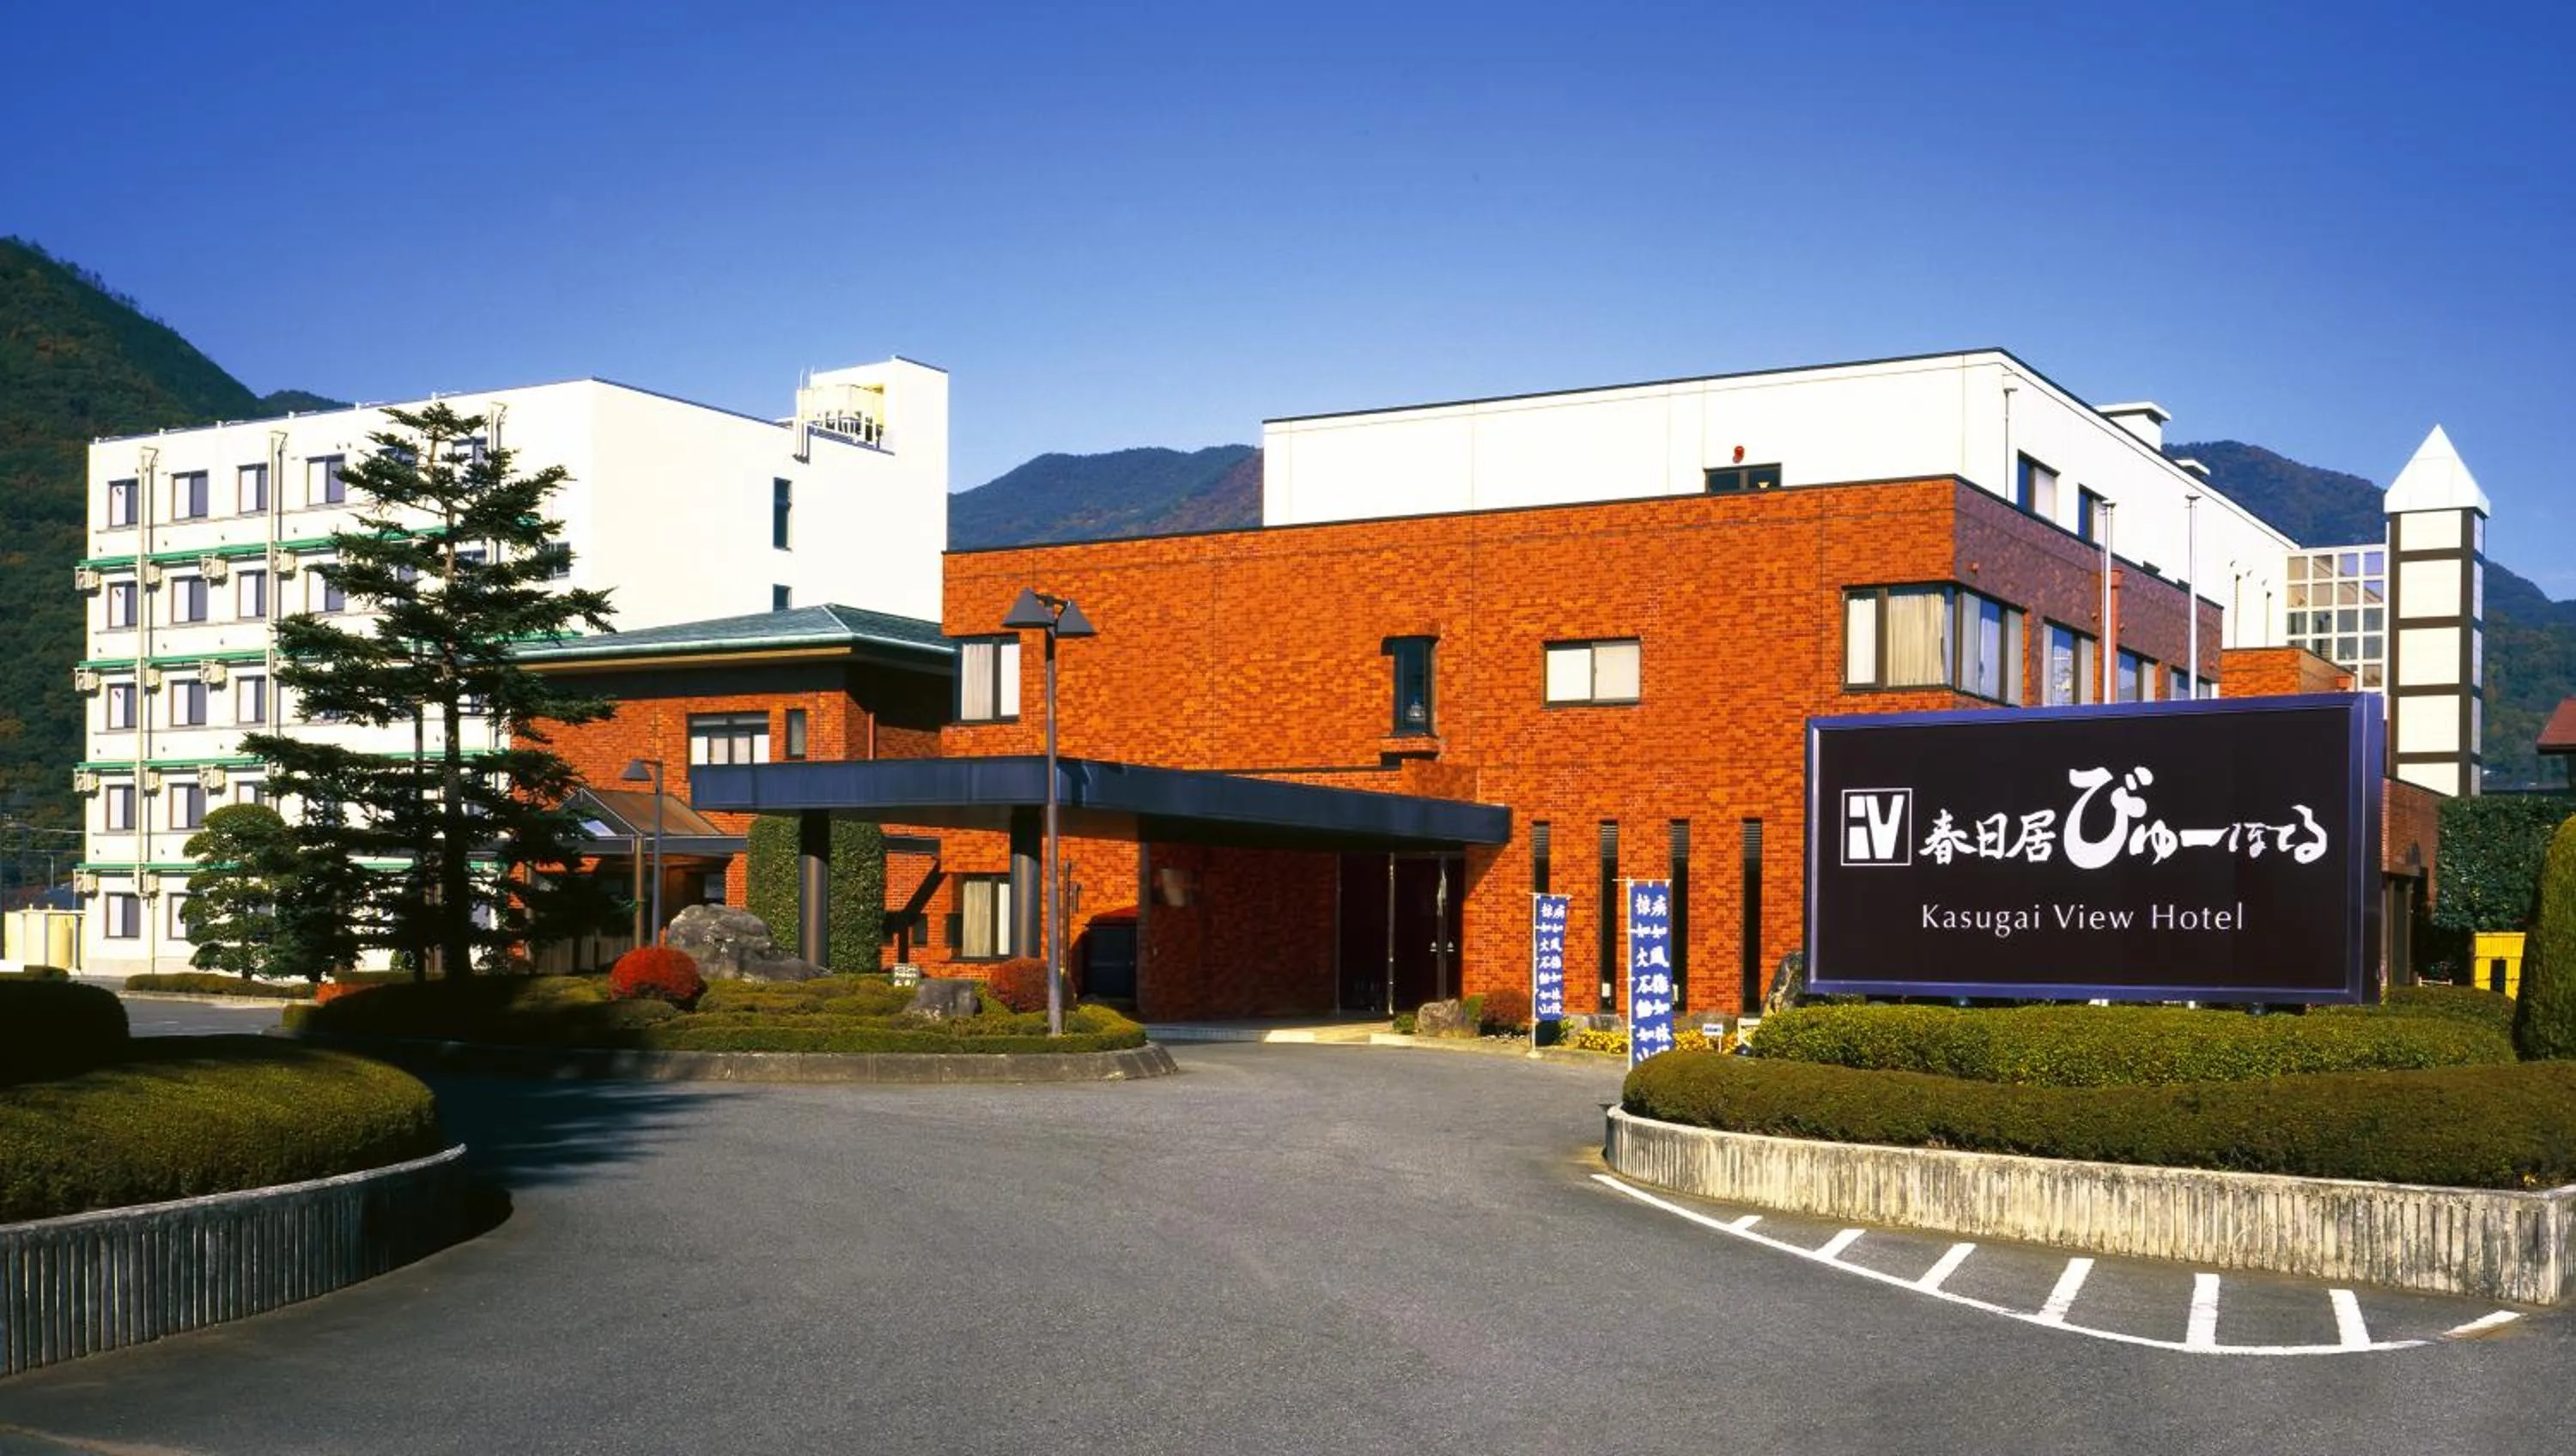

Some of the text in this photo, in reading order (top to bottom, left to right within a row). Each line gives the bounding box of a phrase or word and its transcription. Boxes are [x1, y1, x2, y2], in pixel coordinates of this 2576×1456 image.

[1923, 901, 2242, 937] Kasugai View Hotel
